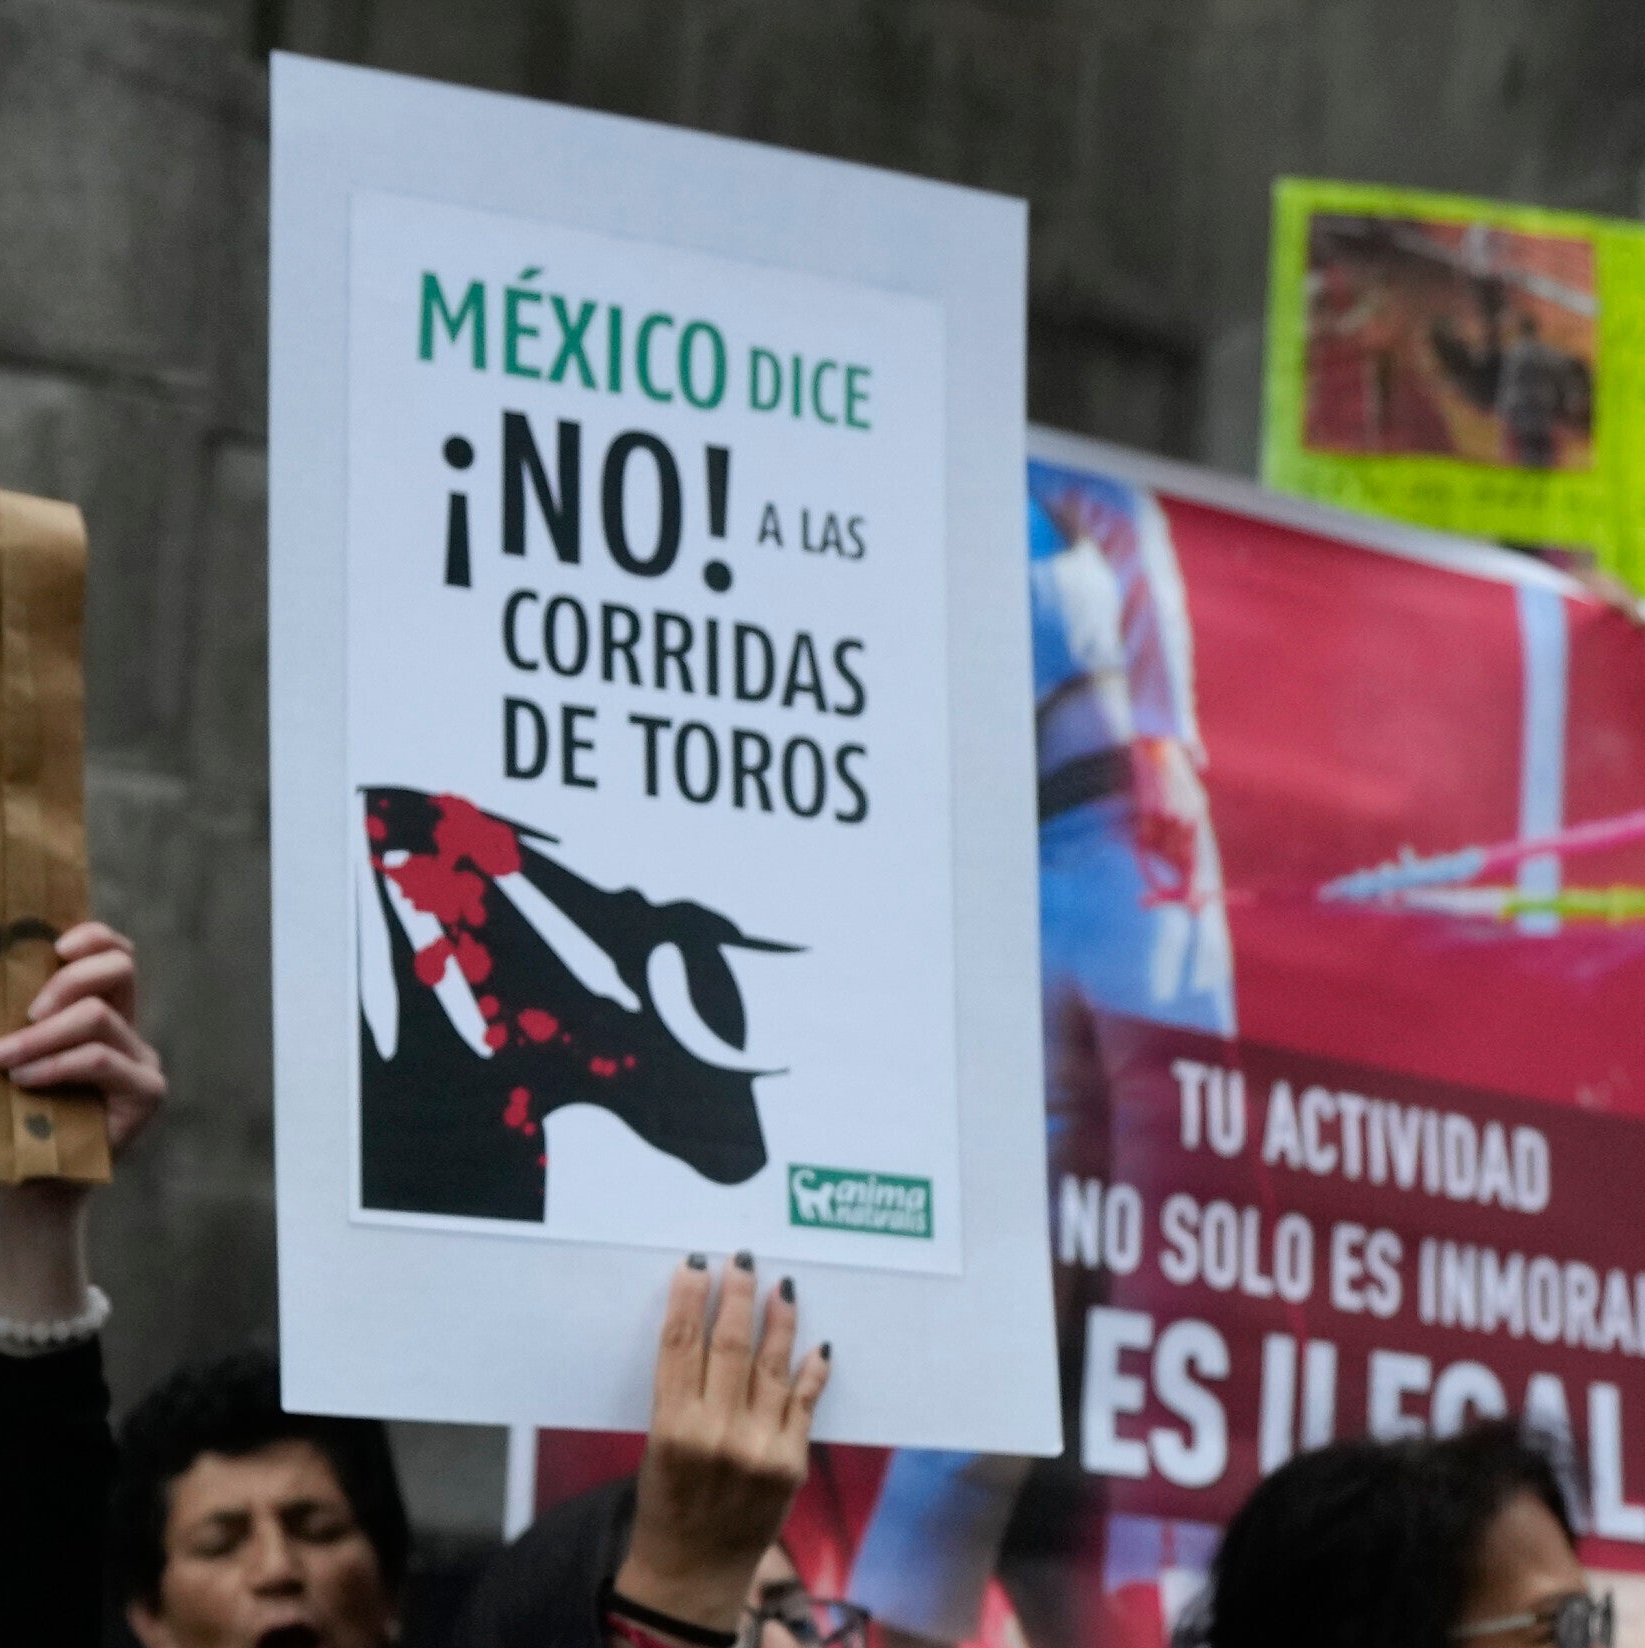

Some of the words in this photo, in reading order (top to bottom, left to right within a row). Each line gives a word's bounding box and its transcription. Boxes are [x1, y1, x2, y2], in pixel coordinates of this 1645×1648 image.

[418, 266, 728, 411] MÉXICO
[750, 348, 872, 431] DICE
[442, 409, 733, 592] ¡NO!
[757, 502, 784, 548] A
[800, 508, 867, 561] LAS
[502, 588, 867, 718] CORRIDAS
[503, 696, 599, 790] DE
[628, 713, 869, 824] TOROS
[1172, 1058, 1246, 1160] TU
[1262, 1080, 1551, 1214] ACTIVIDAD
[1057, 1174, 1144, 1274] NO
[1160, 1193, 1314, 1304] SOLO
[1331, 1222, 1403, 1320] ES
[1080, 1304, 1231, 1490] ES
